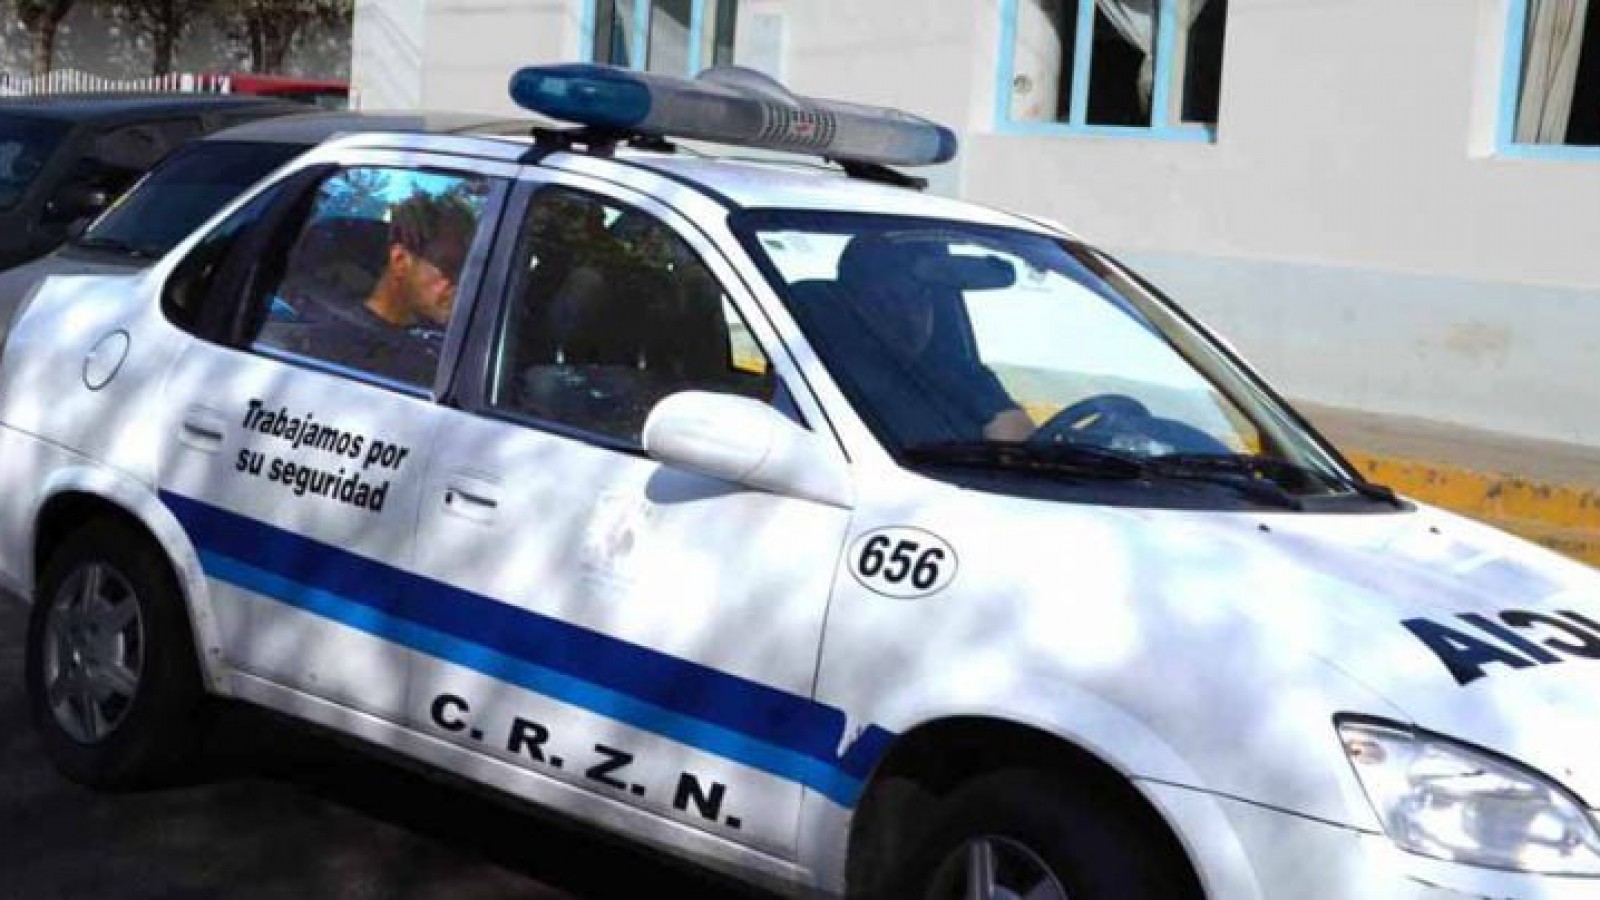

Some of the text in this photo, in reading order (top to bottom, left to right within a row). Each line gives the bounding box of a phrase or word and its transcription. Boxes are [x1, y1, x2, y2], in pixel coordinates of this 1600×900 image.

[242, 399, 410, 470] Trabajamos por
[236, 447, 390, 512] su seguridad
[858, 534, 945, 589] 656
